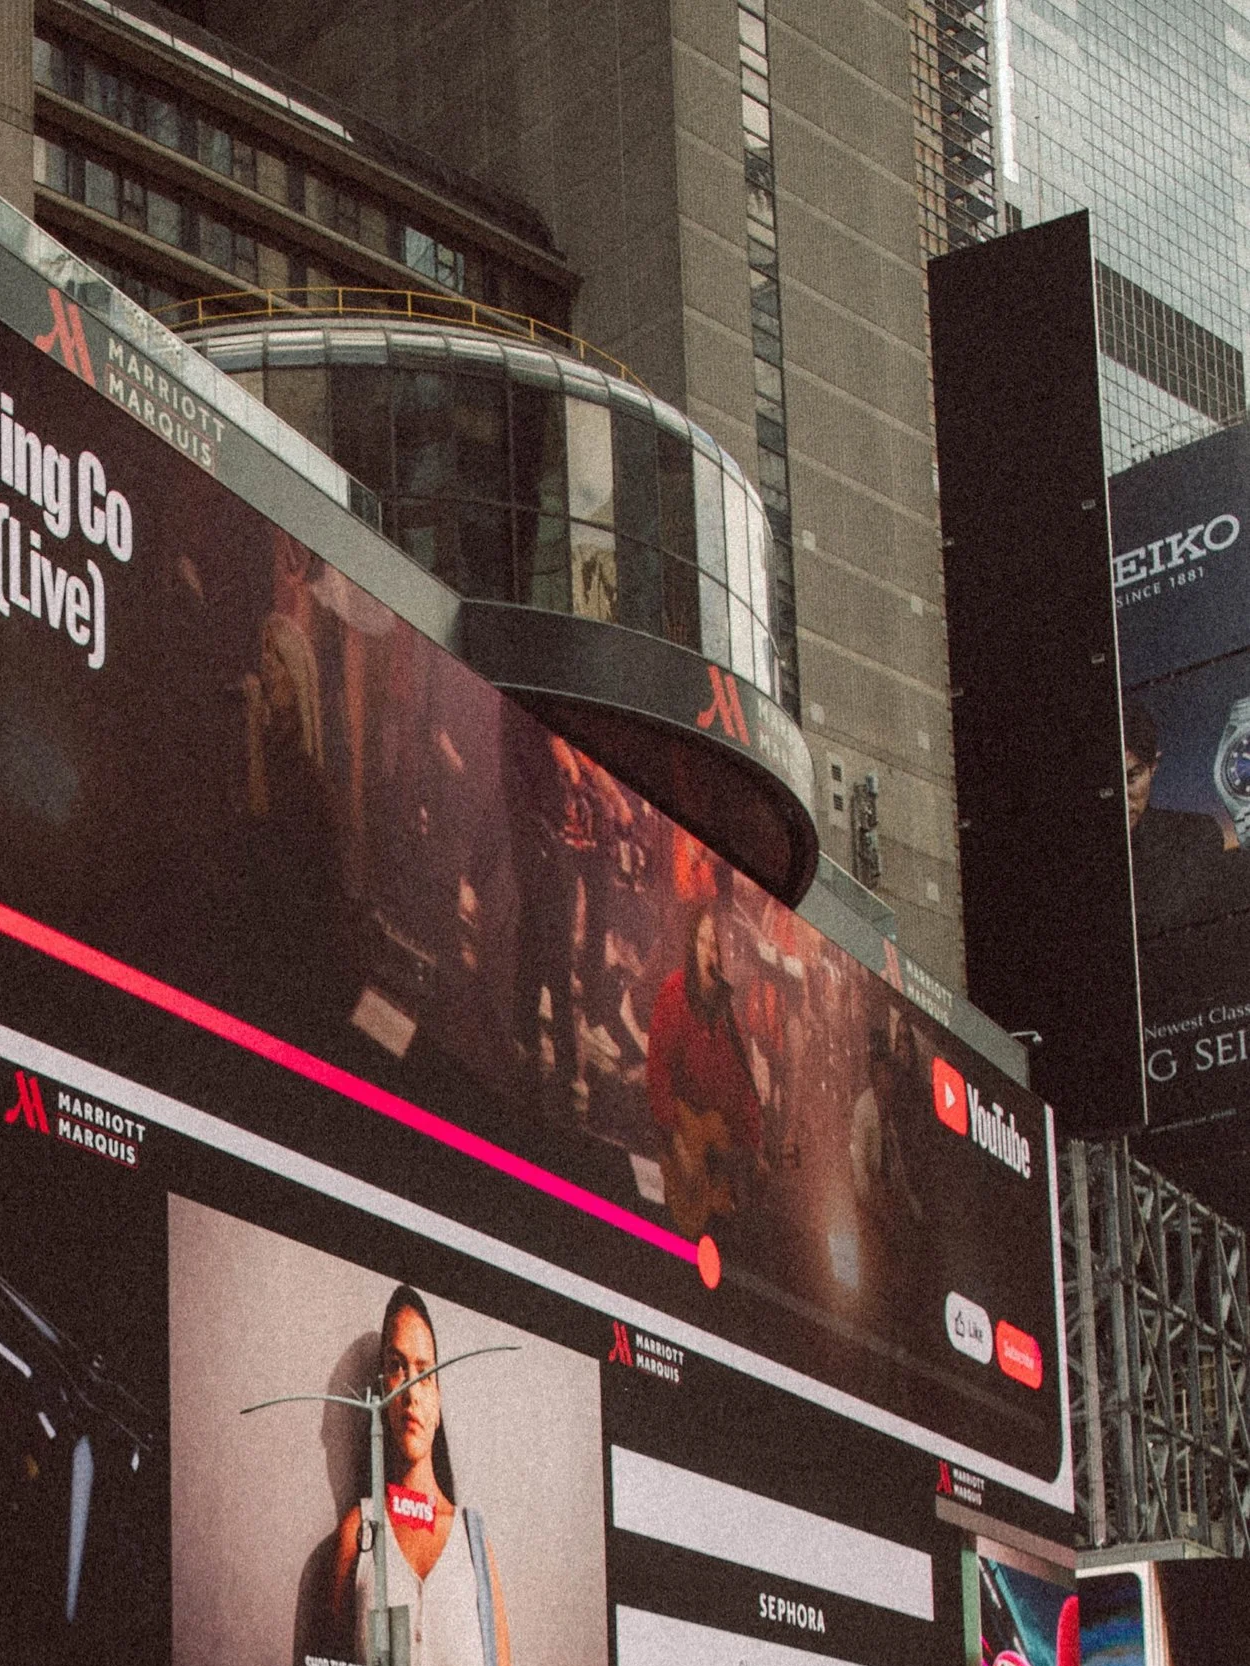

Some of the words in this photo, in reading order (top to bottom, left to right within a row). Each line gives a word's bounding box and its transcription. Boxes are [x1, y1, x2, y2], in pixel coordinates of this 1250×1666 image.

[108, 337, 226, 444] MARRIOTT
[107, 375, 213, 467] MARQUIS
[78, 450, 133, 563] Co
[1113, 514, 1240, 588] EIKO
[1116, 582, 1161, 608] SINCE
[1169, 566, 1205, 589] 1881
[1144, 1015, 1203, 1042] Newest
[1148, 1049, 1177, 1082] G
[58, 1092, 146, 1142] MARRIOTT
[965, 1082, 1032, 1180] YouTube
[58, 1118, 136, 1165] MARQUIS
[635, 1333, 684, 1366] MARRIOTT
[636, 1352, 680, 1383] MARQUIS
[759, 1592, 826, 1634] SEPHORA
